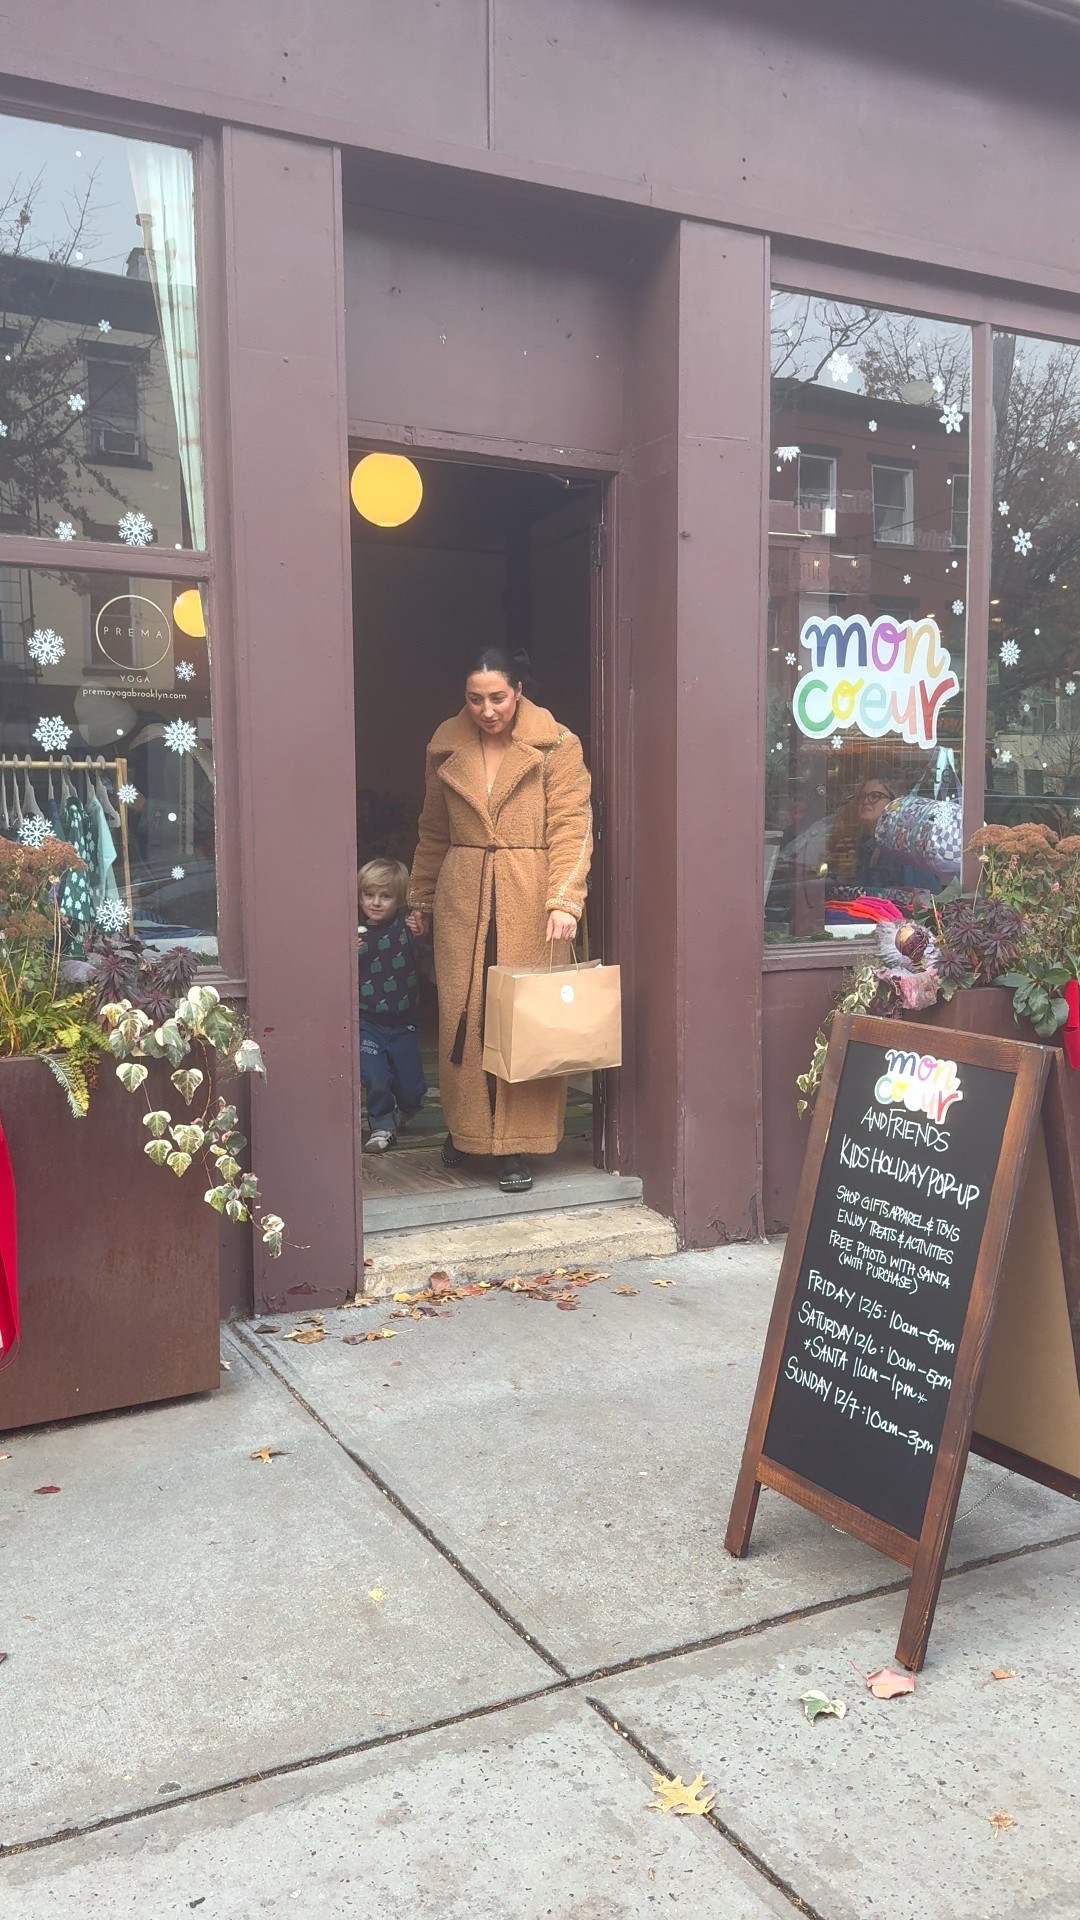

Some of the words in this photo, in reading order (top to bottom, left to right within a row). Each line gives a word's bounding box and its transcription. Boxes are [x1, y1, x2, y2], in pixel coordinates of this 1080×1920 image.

[103, 626, 163, 639] PREMA
[804, 621, 947, 679] mon
[82, 687, 187, 701] premayogabrooklyn.com
[120, 675, 151, 684] YOGA
[797, 677, 955, 742] coeur
[887, 1051, 956, 1090] mon
[875, 1076, 959, 1122] cour
[860, 1106, 888, 1131] AND
[886, 1109, 951, 1152] FRIENDS
[840, 1134, 870, 1168] KIDS
[870, 1147, 930, 1188] HOLIDAY
[926, 1168, 980, 1209] POP-UP
[836, 1185, 860, 1205] SHOP
[926, 1217, 934, 1236] &
[936, 1219, 960, 1242] TOYS
[837, 1209, 868, 1232] ENJOY
[869, 1220, 897, 1242] TREATS
[898, 1231, 904, 1249] &
[903, 1236, 954, 1264] ACTIVITIES
[829, 1229, 853, 1251] FREE
[857, 1241, 887, 1264] PHOTO
[890, 1256, 915, 1276] WITH
[917, 1266, 951, 1289] SANTA
[838, 1252, 863, 1270] (WITH
[866, 1262, 918, 1294] PURCHASE)
[807, 1270, 856, 1308] FRIDAY
[858, 1296, 887, 1319] 12/5:
[798, 1301, 854, 1345] SATURDAY
[785, 1356, 833, 1402] SUNDAY
